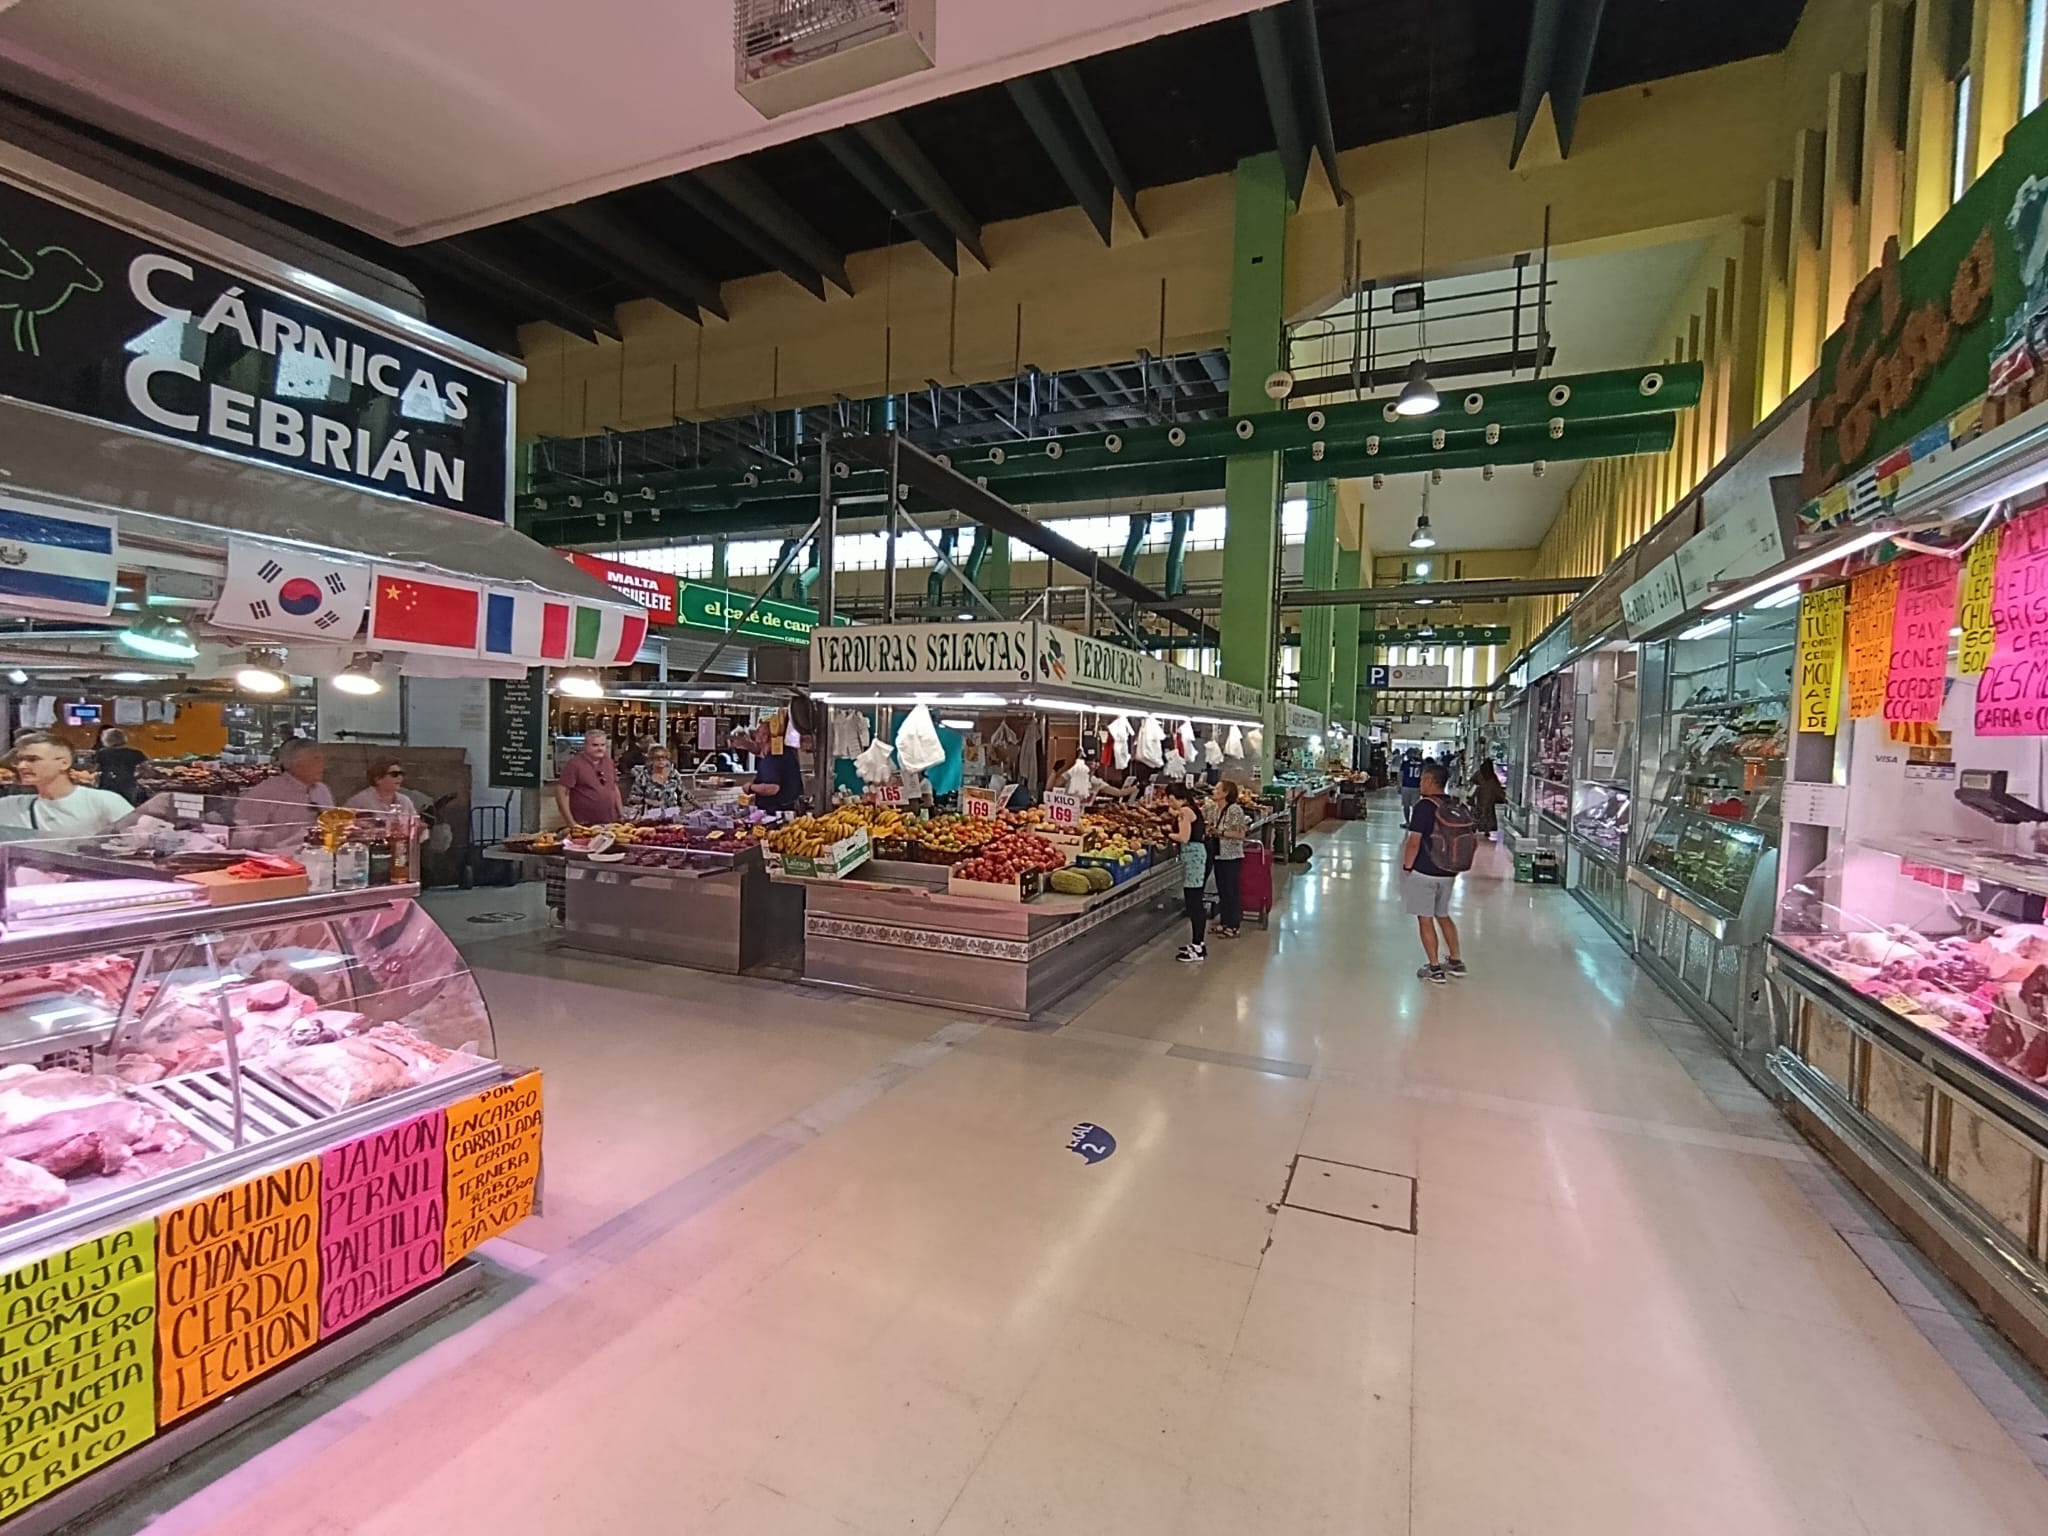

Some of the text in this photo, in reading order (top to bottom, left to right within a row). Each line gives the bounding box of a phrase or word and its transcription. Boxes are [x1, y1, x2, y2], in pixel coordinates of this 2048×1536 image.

[128, 253, 469, 420] CÁRNICAS
[125, 354, 466, 502] CEBRIÁN
[607, 571, 659, 591] MALTA
[704, 601, 721, 616] el
[723, 607, 760, 623] caé
[762, 612, 781, 627] de
[818, 631, 1026, 673] VERDURAS SELECTAS
[1074, 637, 1143, 688] VERDURAS
[1371, 667, 1385, 685] P
[1875, 755, 1898, 764] VISA
[880, 786, 900, 801] 165
[967, 800, 989, 817] 169
[1049, 806, 1072, 823] 169
[1054, 795, 1075, 806] KILO
[450, 1090, 537, 1141] ENCARGO
[325, 1112, 440, 1191] JAMÓN
[475, 1137, 522, 1169] CERDO
[1081, 1143, 1107, 1154] 2
[324, 1158, 437, 1236] PERNIL
[458, 1151, 530, 1200] TERNERA
[165, 1162, 314, 1258] COCHINO
[462, 1201, 519, 1249] PAVO
[167, 1213, 311, 1306] CHANCHO
[322, 1239, 439, 1329] CODILLO
[7, 1254, 144, 1325] AGUJA
[172, 1258, 308, 1359] CERDO
[0, 1292, 121, 1358] LOMO
[176, 1303, 311, 1412] LECHON
[3, 1363, 143, 1446] PANCETA
